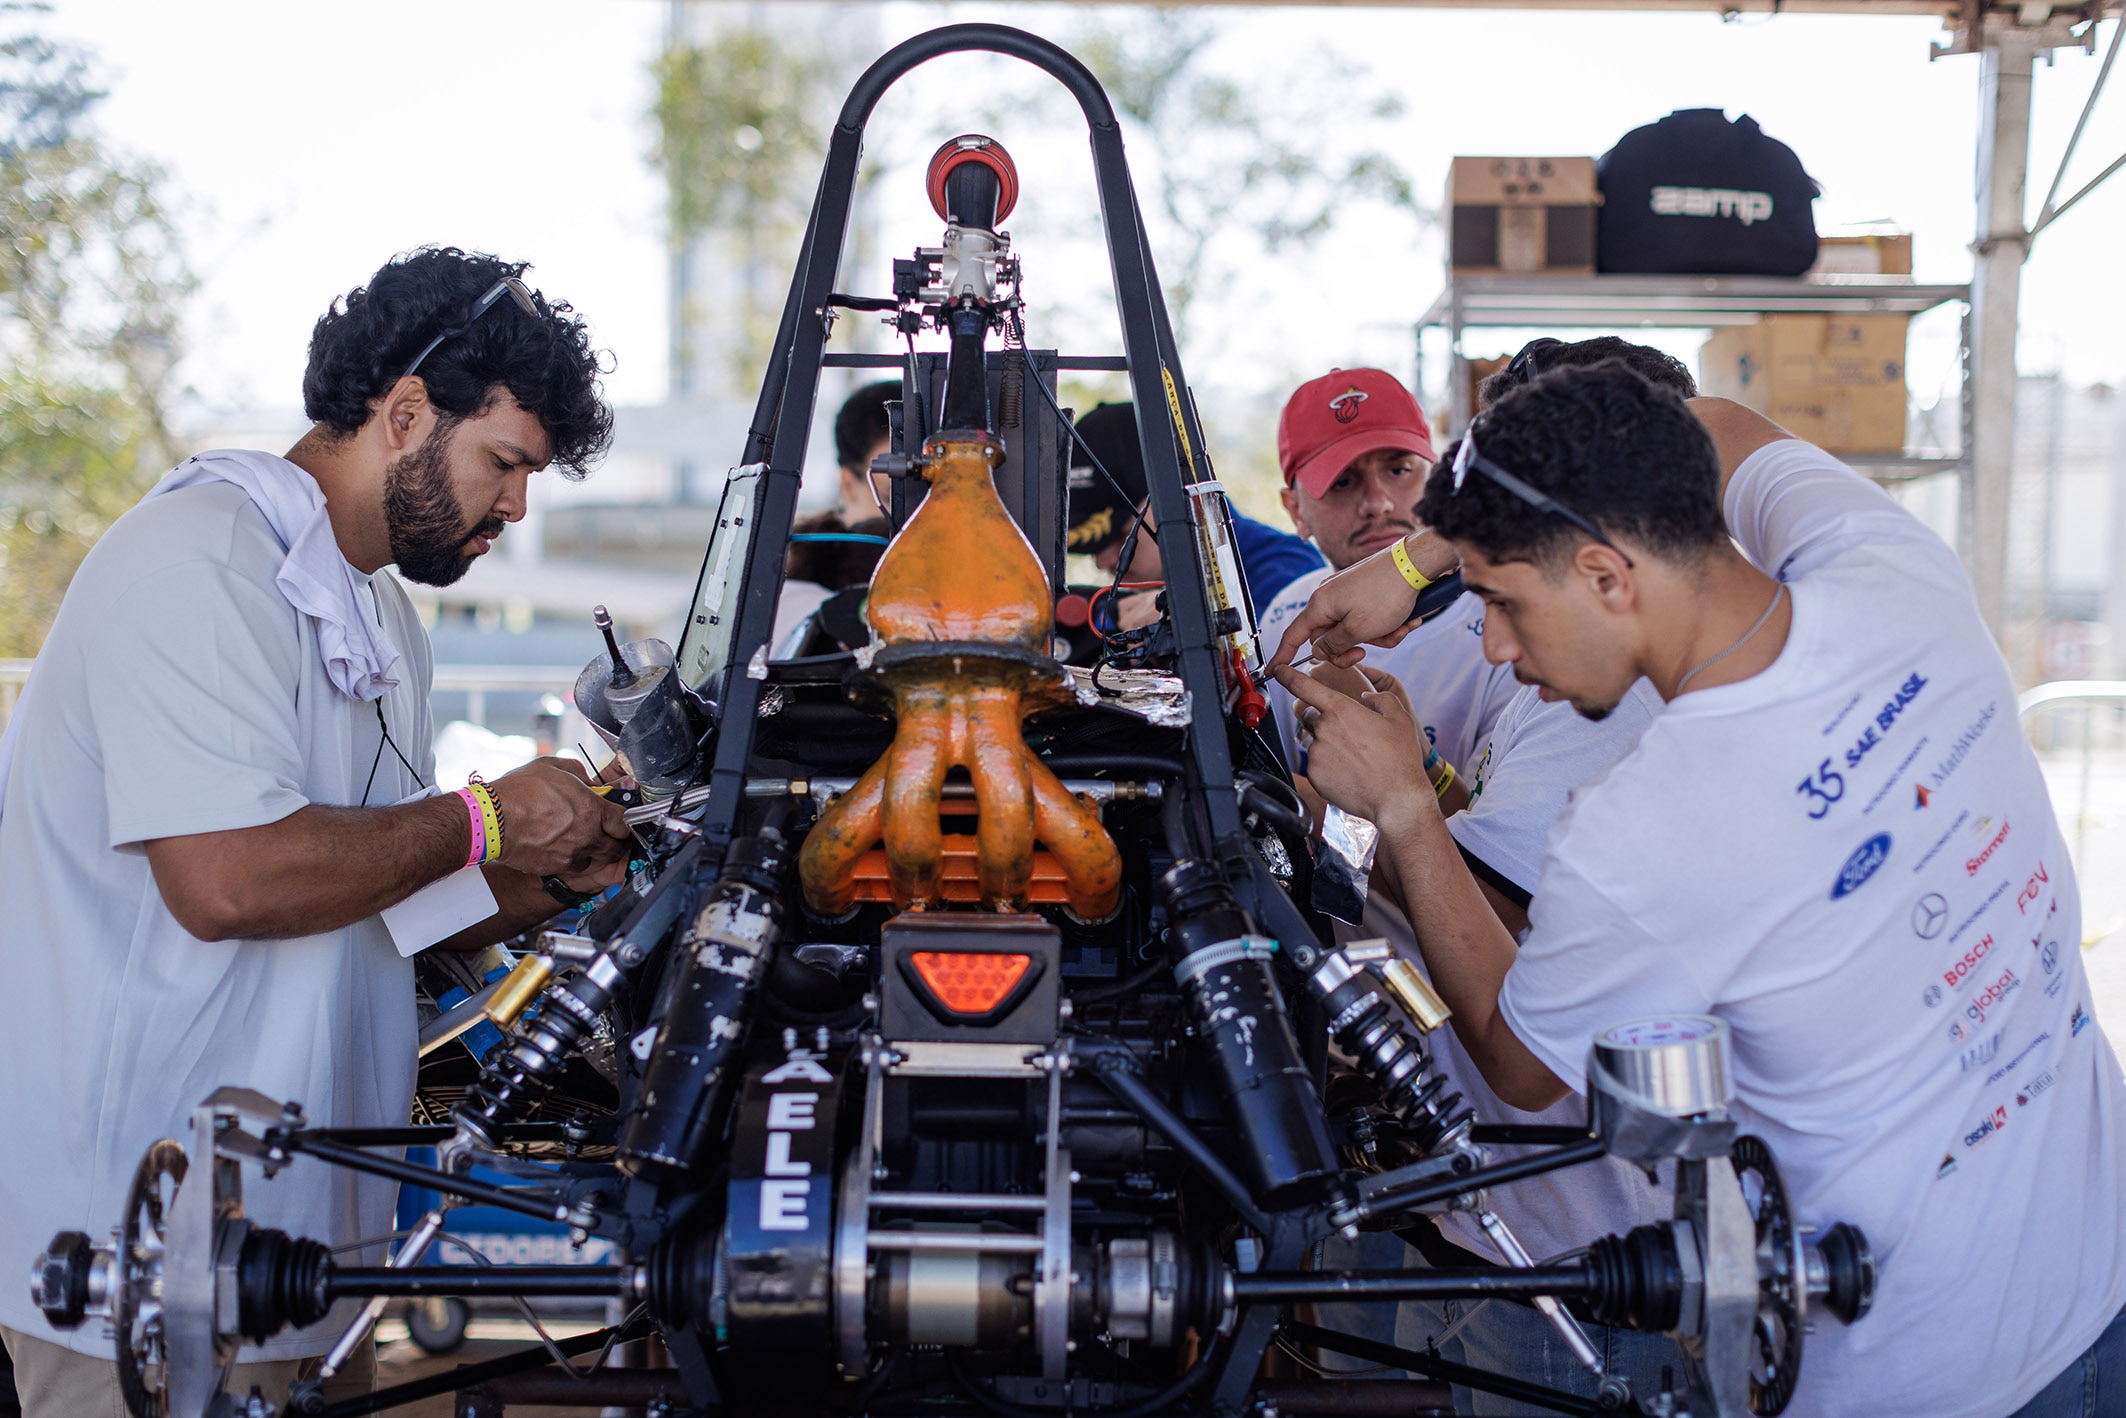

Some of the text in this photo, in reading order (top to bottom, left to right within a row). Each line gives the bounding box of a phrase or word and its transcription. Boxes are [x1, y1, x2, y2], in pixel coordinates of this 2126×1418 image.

[1220, 592, 1229, 609] DA
[1796, 672, 1929, 820] 35 SAE BRASIL
[1930, 700, 1997, 788] MathWorks
[1842, 840, 1881, 892] Ford
[1943, 932, 1994, 988] BOSCH
[1967, 967, 2016, 1024] global
